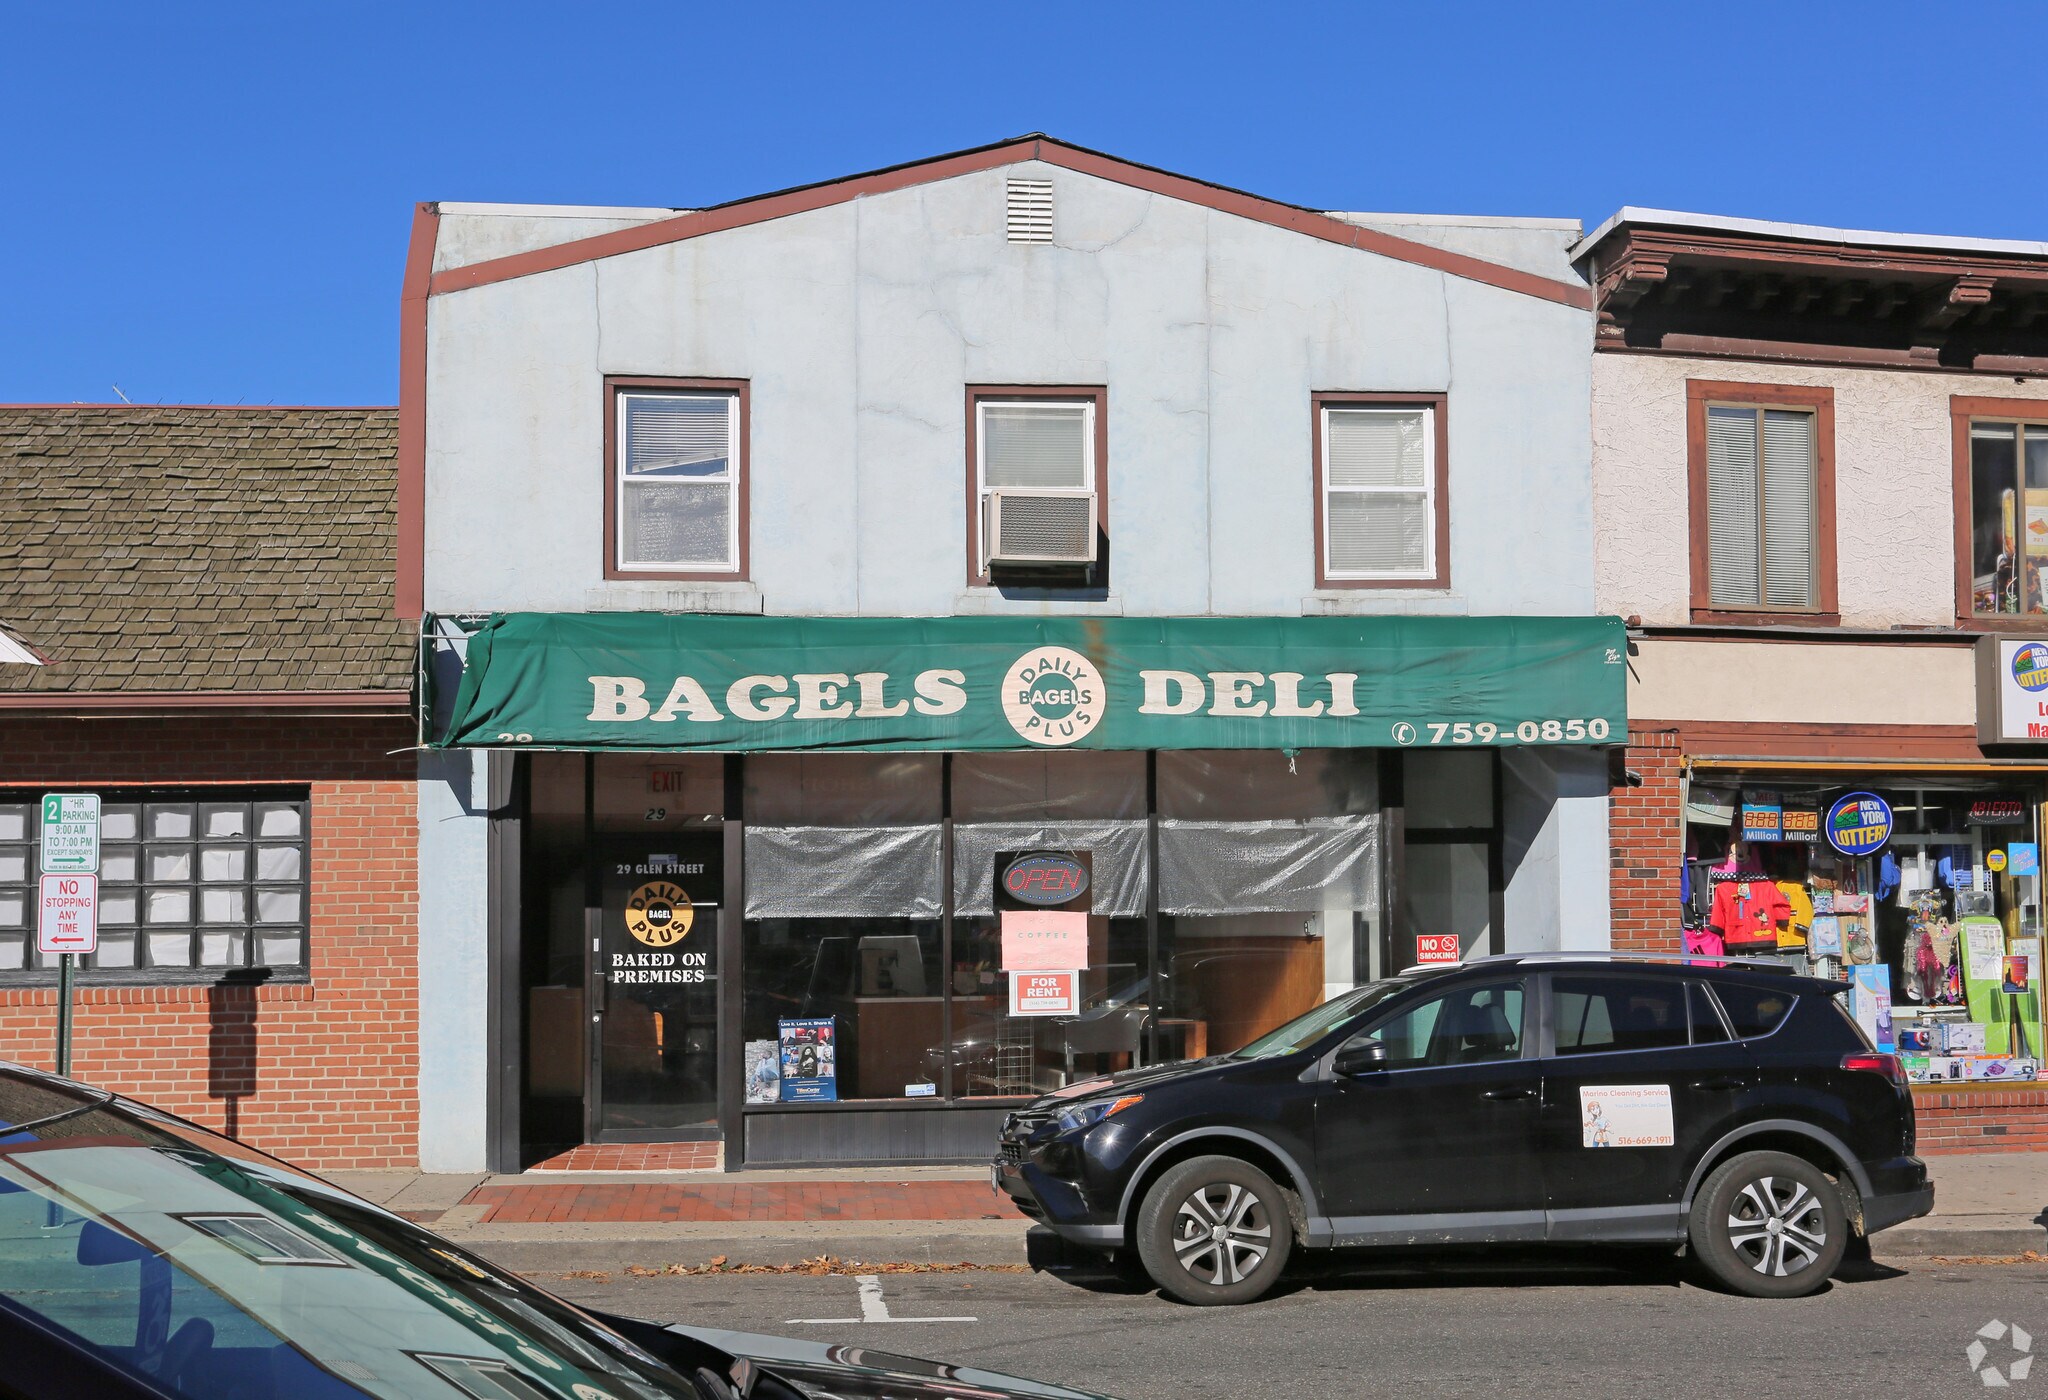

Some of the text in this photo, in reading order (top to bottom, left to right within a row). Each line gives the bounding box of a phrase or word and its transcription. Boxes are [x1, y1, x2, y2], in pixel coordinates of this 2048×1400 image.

[2031, 647, 2048, 657] NEW
[1020, 657, 1087, 684] DAILY
[2016, 668, 2048, 687] LOTTE
[587, 669, 967, 721] BAGELS
[1019, 689, 1092, 705] BAGELS
[1138, 670, 1361, 717] DELI
[1026, 711, 1091, 737] PLUS
[1426, 718, 1610, 744] 759-0850
[652, 771, 684, 792] EXIT
[74, 799, 84, 808] HR
[1860, 801, 1880, 811] NEW
[48, 801, 58, 820] 2
[646, 808, 666, 820] 29
[1969, 802, 2023, 817] ABIERTO
[62, 811, 95, 820] PARKING
[1861, 811, 1886, 825] YORK
[55, 825, 86, 834] 9:00 AM
[1834, 824, 1888, 846] LOTTERY
[1746, 832, 1778, 840] Million
[1785, 832, 1817, 841] Million
[48, 837, 92, 847] TO 7:00 PM
[616, 864, 705, 874] 29 GLEN STREET
[1008, 868, 1082, 891] OPEN
[59, 880, 79, 895] NO
[46, 898, 91, 907] STOPPING
[631, 884, 690, 912] DAILY
[58, 911, 77, 920] ANY
[648, 910, 671, 919] BAGEL
[57, 923, 78, 933] TIME
[632, 920, 685, 943] PLUS
[1421, 939, 1438, 950] NO
[612, 953, 707, 967] BAKED ON
[1419, 952, 1456, 960] SMOKING
[612, 969, 705, 983] PREMISES
[1031, 977, 1057, 987] FOR
[1027, 988, 1061, 997] RENT
[1610, 1089, 1641, 1098] Cleaning
[1618, 1136, 1671, 1145] 516-669-1911
